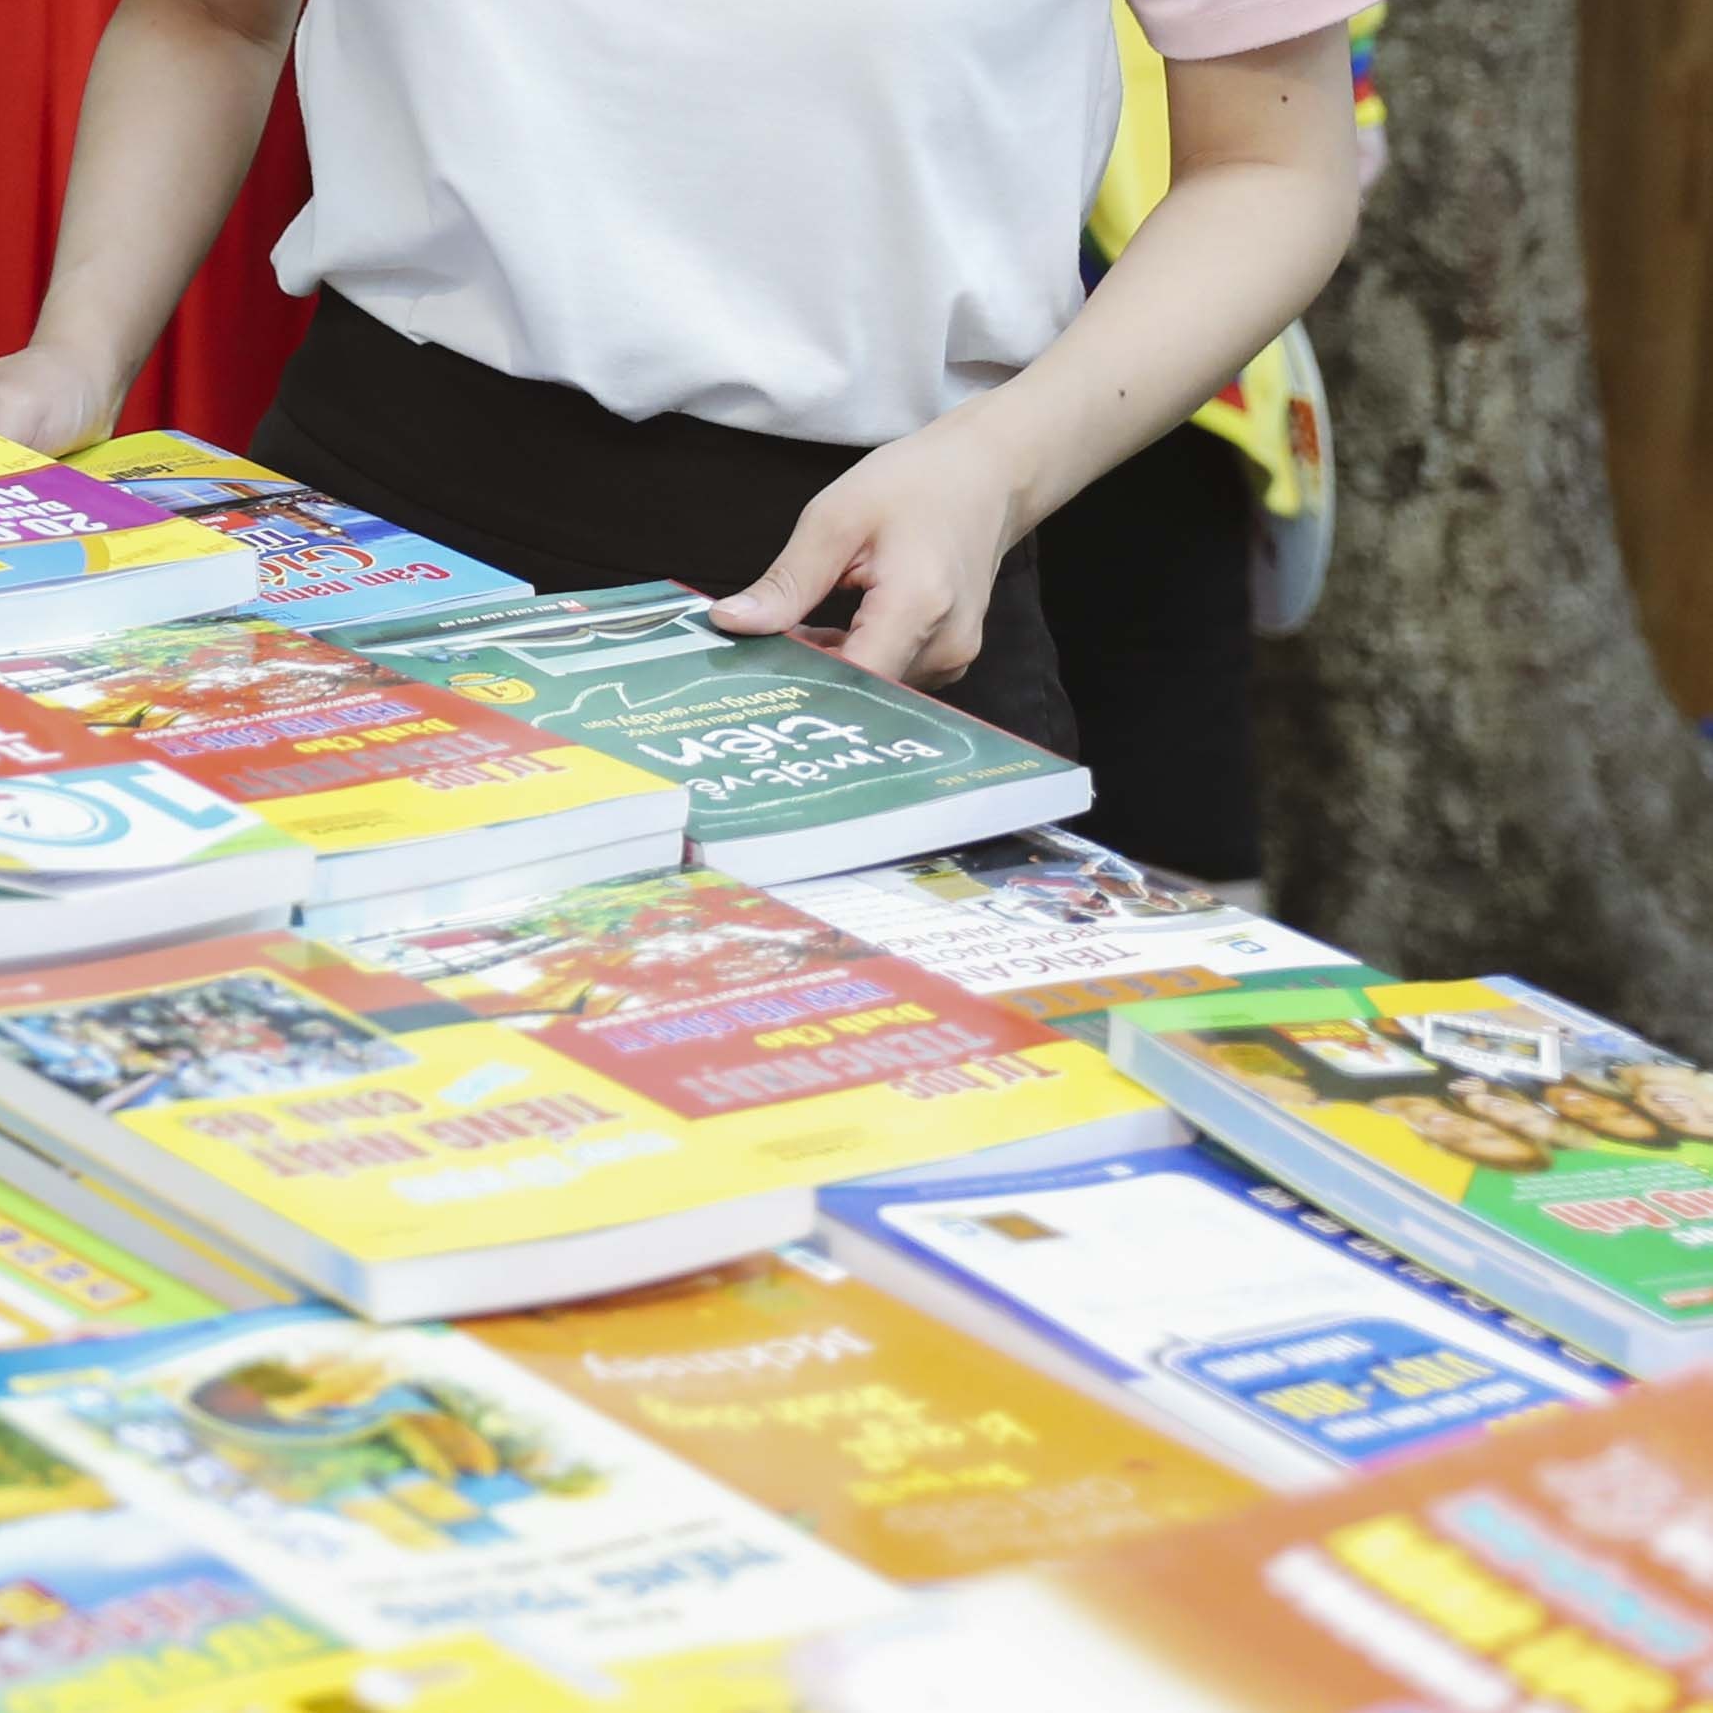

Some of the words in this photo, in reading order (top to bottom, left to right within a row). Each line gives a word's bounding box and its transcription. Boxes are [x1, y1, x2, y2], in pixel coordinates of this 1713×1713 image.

[636, 715, 868, 767] tiền
[875, 738, 944, 764] Bí
[749, 748, 881, 788] mật
